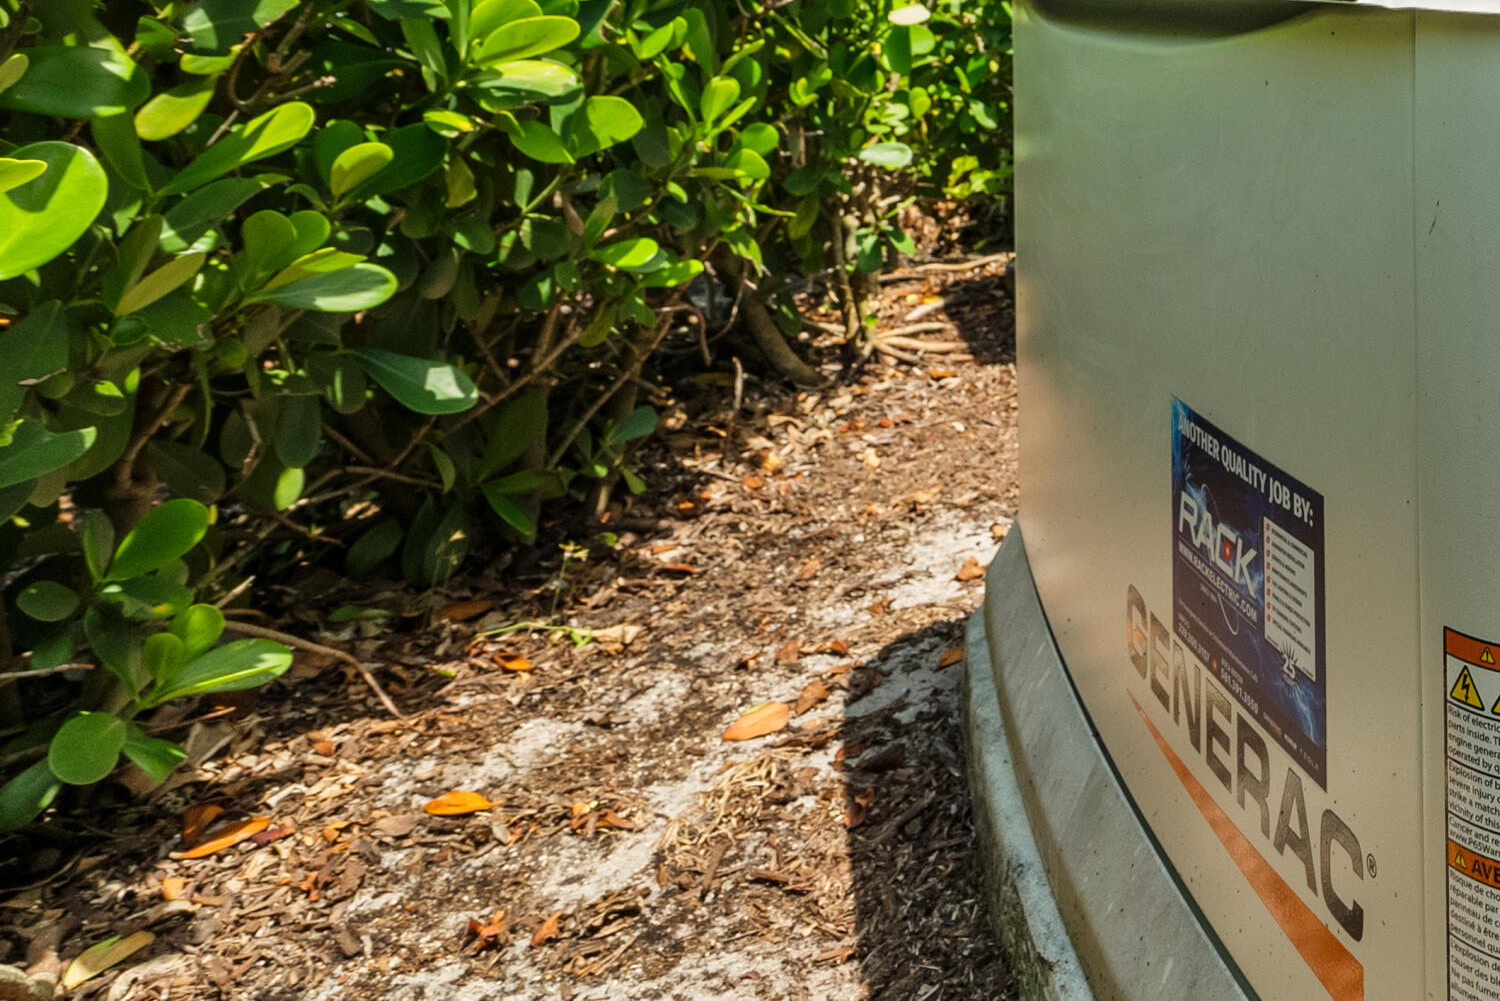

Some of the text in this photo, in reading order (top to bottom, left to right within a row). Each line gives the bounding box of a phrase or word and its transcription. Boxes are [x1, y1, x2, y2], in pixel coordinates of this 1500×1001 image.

[1178, 414, 1314, 527] ANOTHER QUALITY JOB BY:
[1178, 490, 1258, 600] RACK
[1282, 653, 1296, 679] 25
[1448, 705, 1461, 719] Risk
[1462, 713, 1470, 723] of
[1471, 717, 1500, 733] electric
[1448, 719, 1465, 734] parts
[1466, 726, 1492, 744] inside.
[1448, 732, 1472, 750] engine
[1127, 583, 1364, 942] GENERAC
[1448, 745, 1480, 766] operated
[1482, 758, 1493, 771] by
[1448, 761, 1483, 784] Explosion
[1484, 778, 1493, 788] of
[1472, 785, 1495, 803] injury
[1468, 798, 1473, 807] a
[1474, 801, 1500, 816] match
[1448, 815, 1473, 835] Cancer
[1474, 831, 1490, 843] and
[1474, 813, 1484, 823] of
[1484, 816, 1500, 829] this
[1473, 884, 1484, 895] de
[1482, 913, 1493, 925] de
[1484, 903, 1499, 914] par
[1476, 923, 1482, 933] à
[1482, 926, 1500, 941] être
[1474, 968, 1488, 981] des
